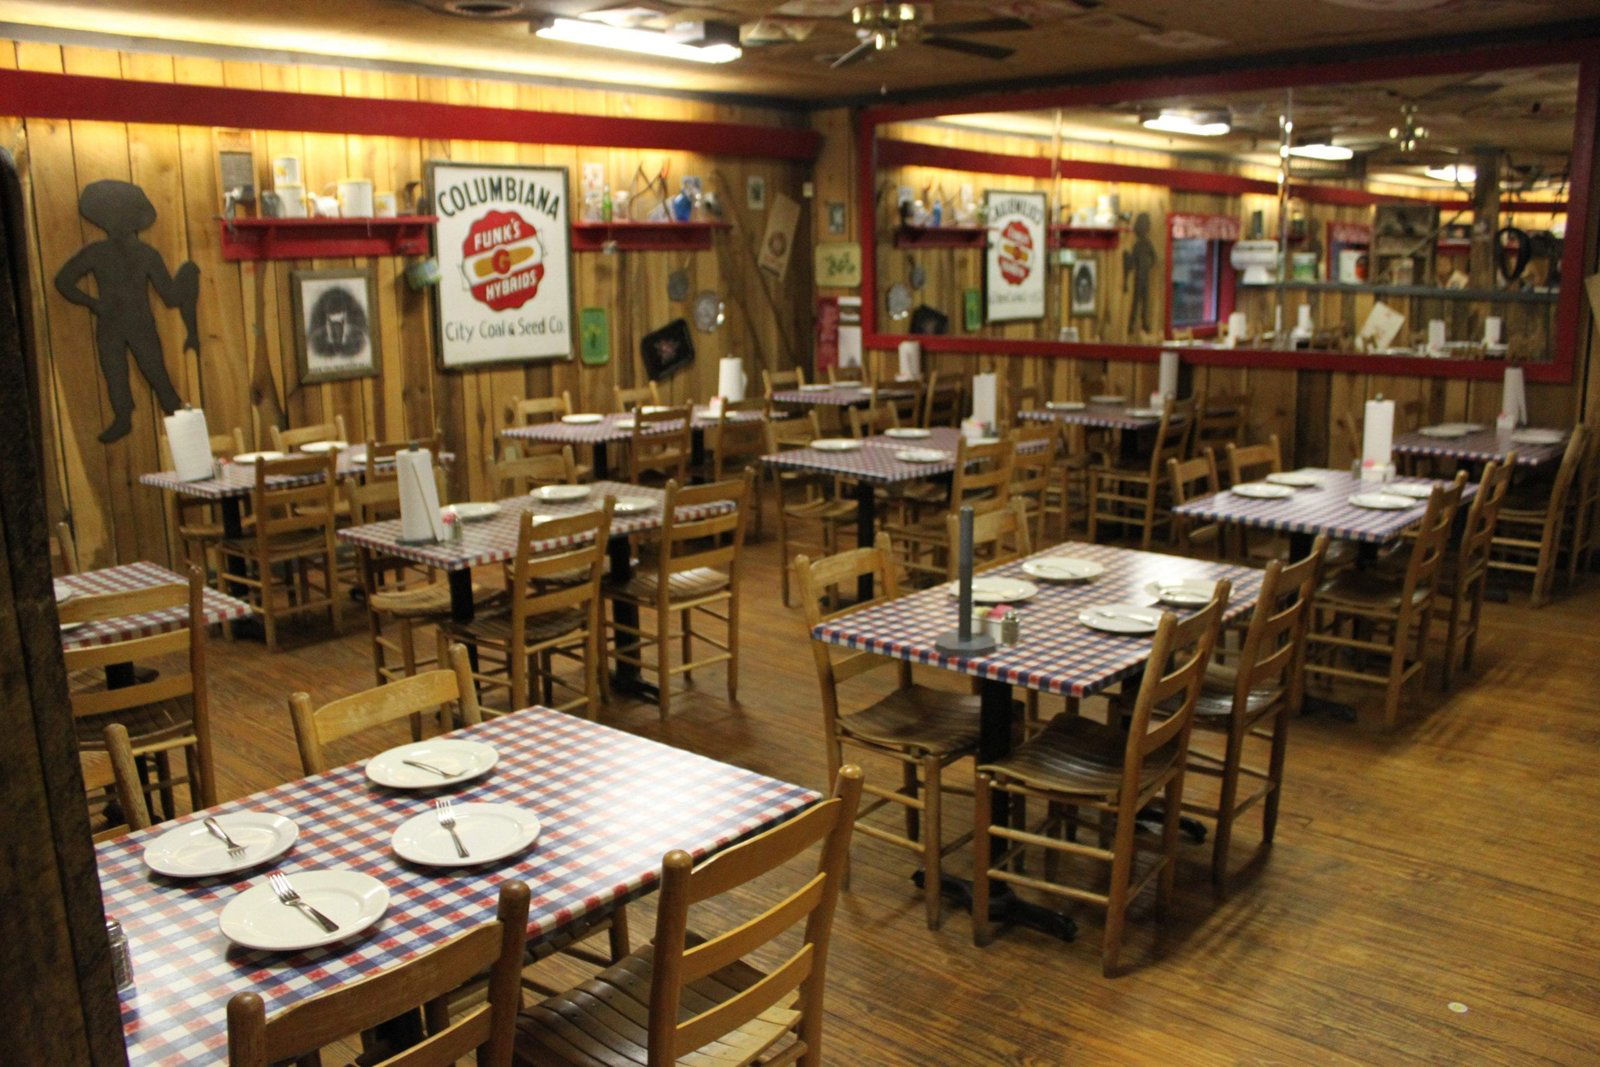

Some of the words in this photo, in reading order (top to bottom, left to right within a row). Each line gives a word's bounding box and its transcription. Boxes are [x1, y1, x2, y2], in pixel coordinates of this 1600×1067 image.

[438, 176, 560, 221] COLUMBIANA
[474, 218, 521, 251] FUNK'S
[485, 269, 537, 301] HYBRIDS
[445, 321, 474, 343] City
[480, 320, 505, 339] Coal
[518, 316, 545, 337] Seed
